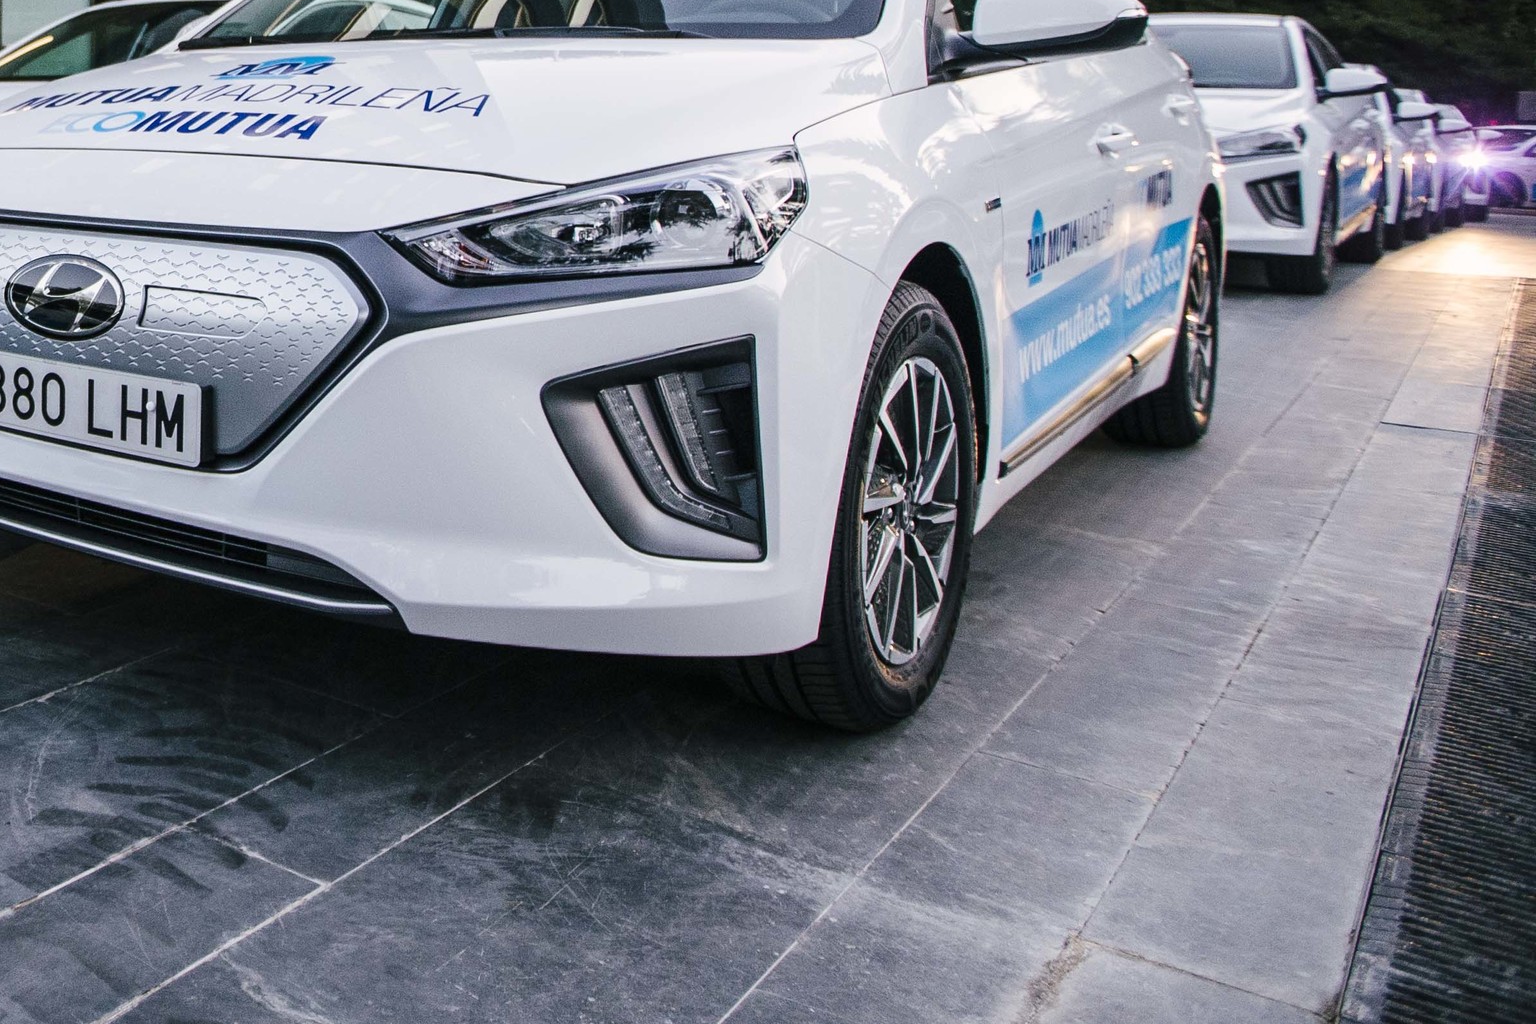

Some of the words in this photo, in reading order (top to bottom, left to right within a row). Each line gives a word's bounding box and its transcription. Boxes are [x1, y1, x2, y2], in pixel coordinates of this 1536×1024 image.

[5, 84, 490, 117] MUTUAMADRILEÑA
[39, 110, 328, 141] ECOMUTUA
[1019, 294, 1112, 384] www.mutua.es
[88, 378, 184, 453] LHM
